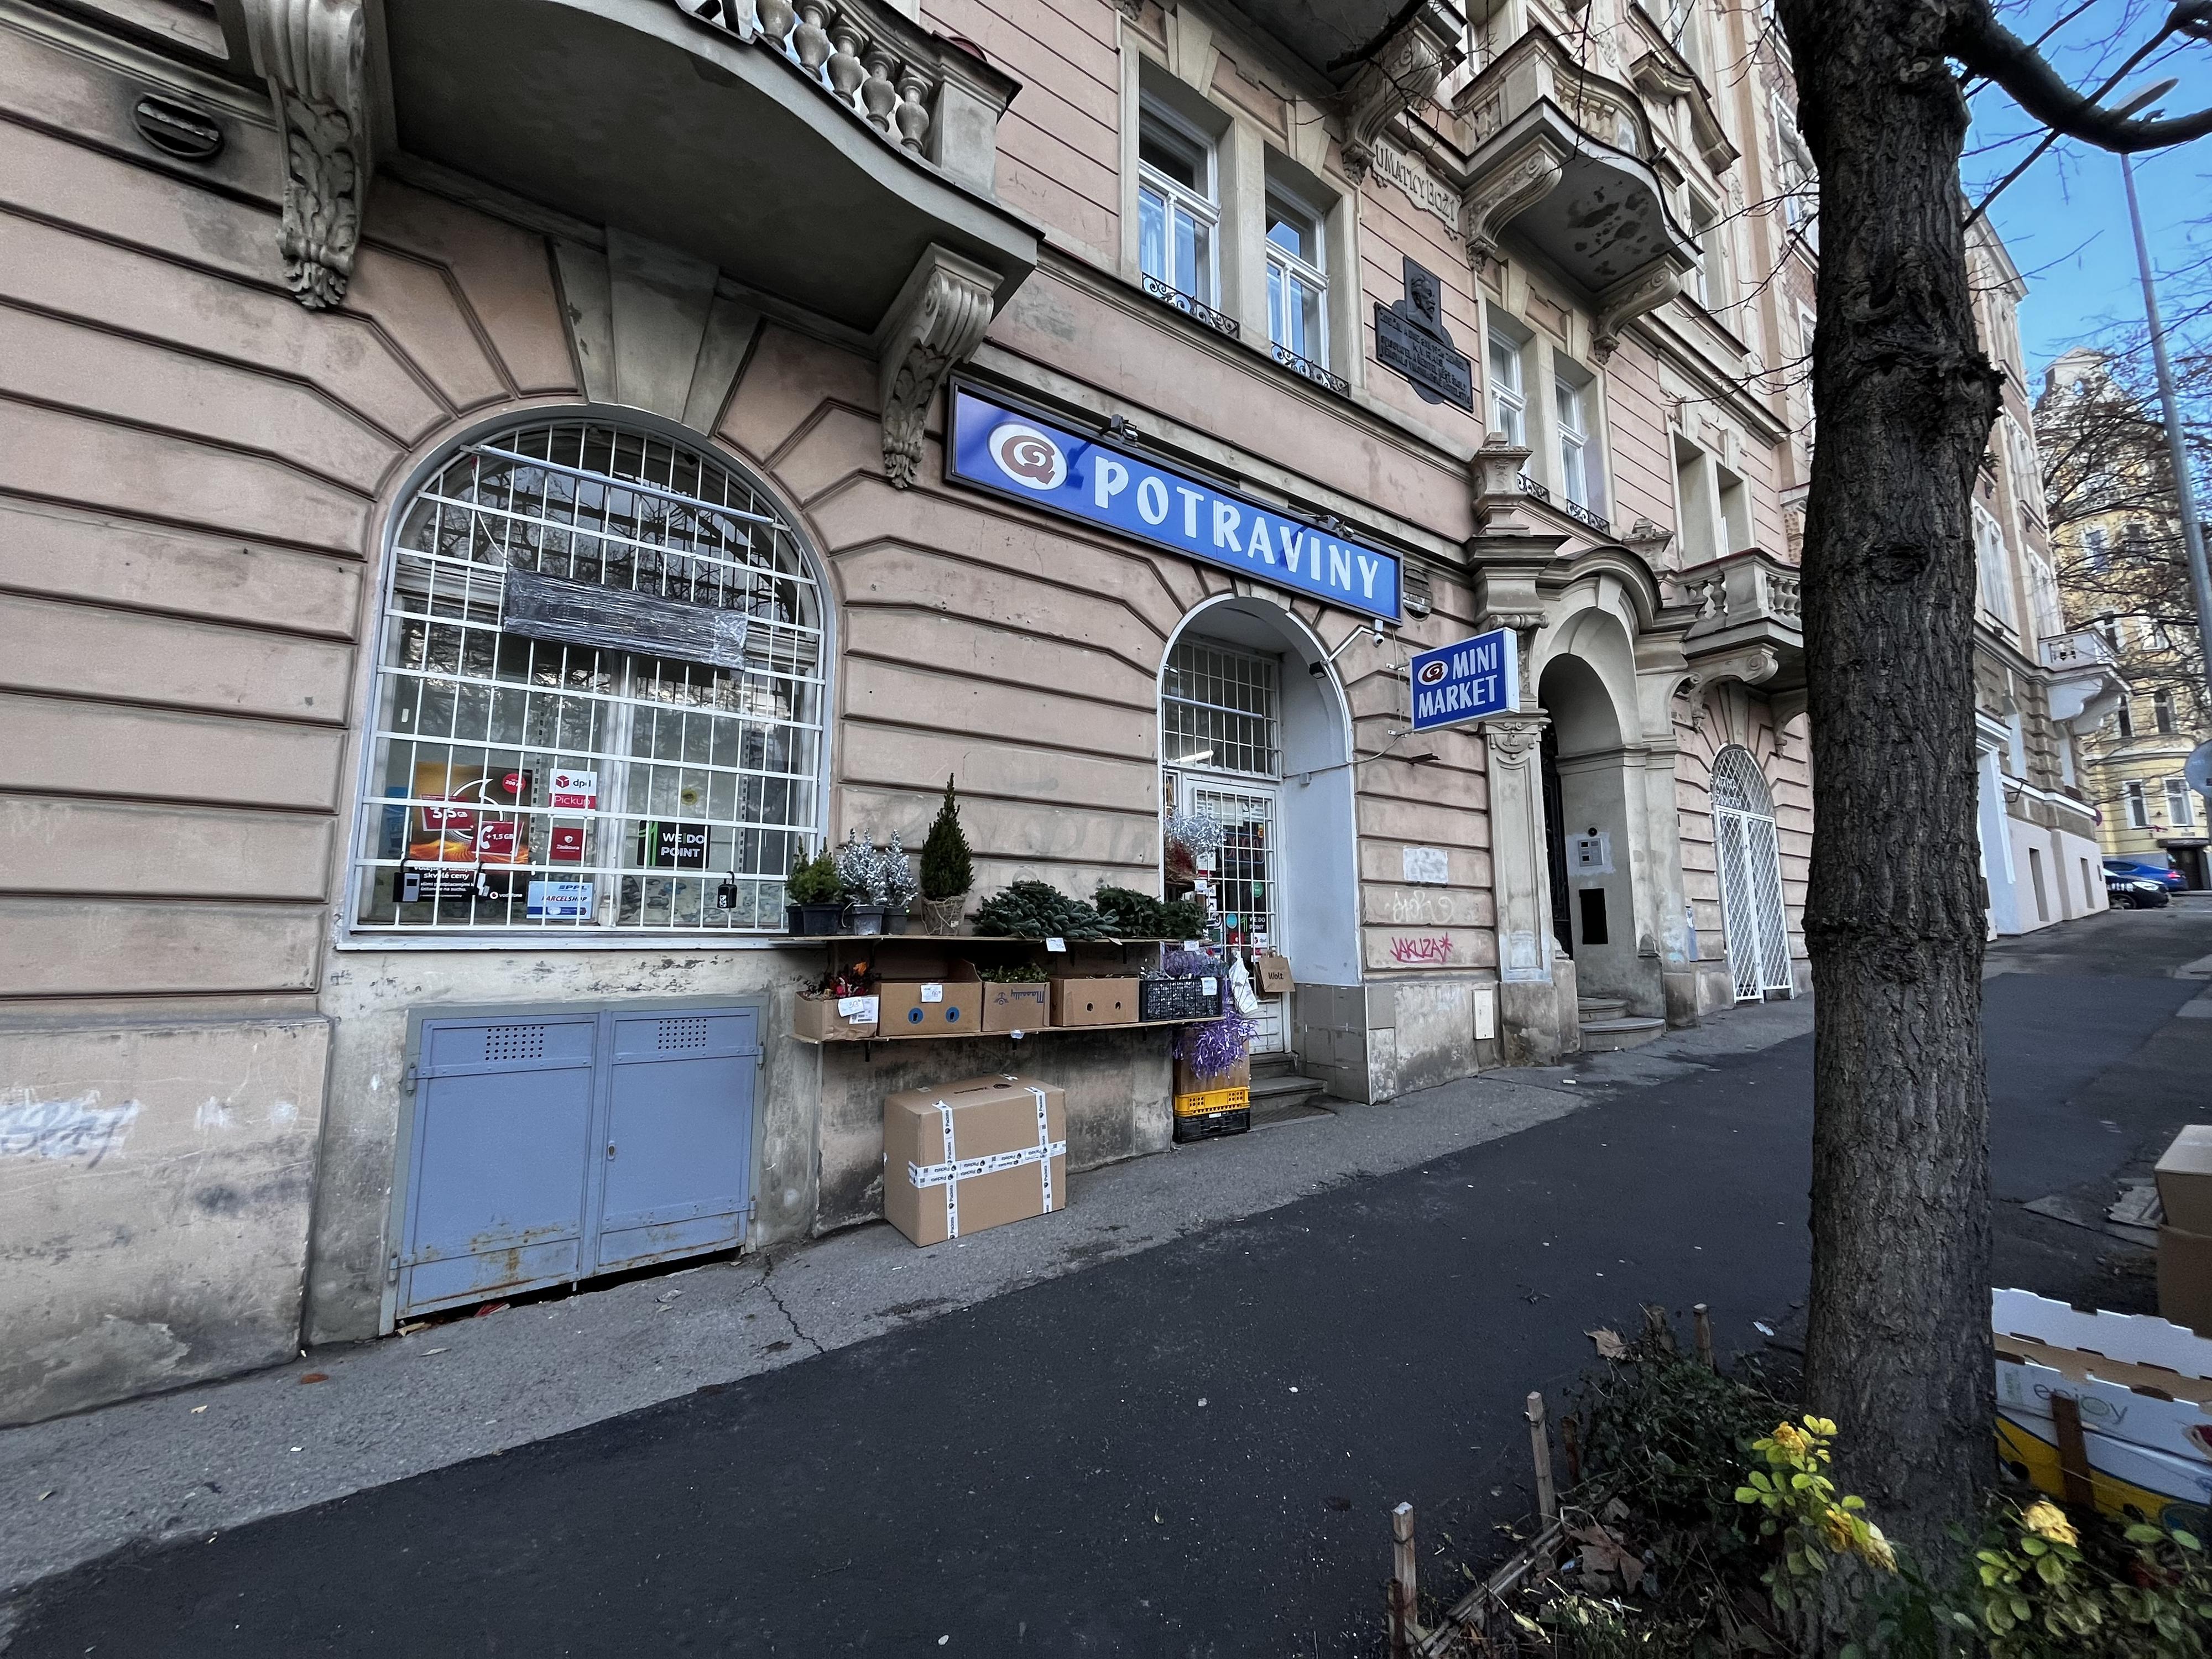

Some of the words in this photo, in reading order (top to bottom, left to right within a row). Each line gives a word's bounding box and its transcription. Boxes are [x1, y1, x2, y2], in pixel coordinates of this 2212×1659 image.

[1384, 148, 1425, 199] MATKY
[1094, 456, 1379, 599] POTRAVINY
[1452, 643, 1498, 680] MINI
[1418, 675, 1498, 719] MARKET
[554, 795, 591, 808] Pickup
[661, 847, 701, 858] POINT
